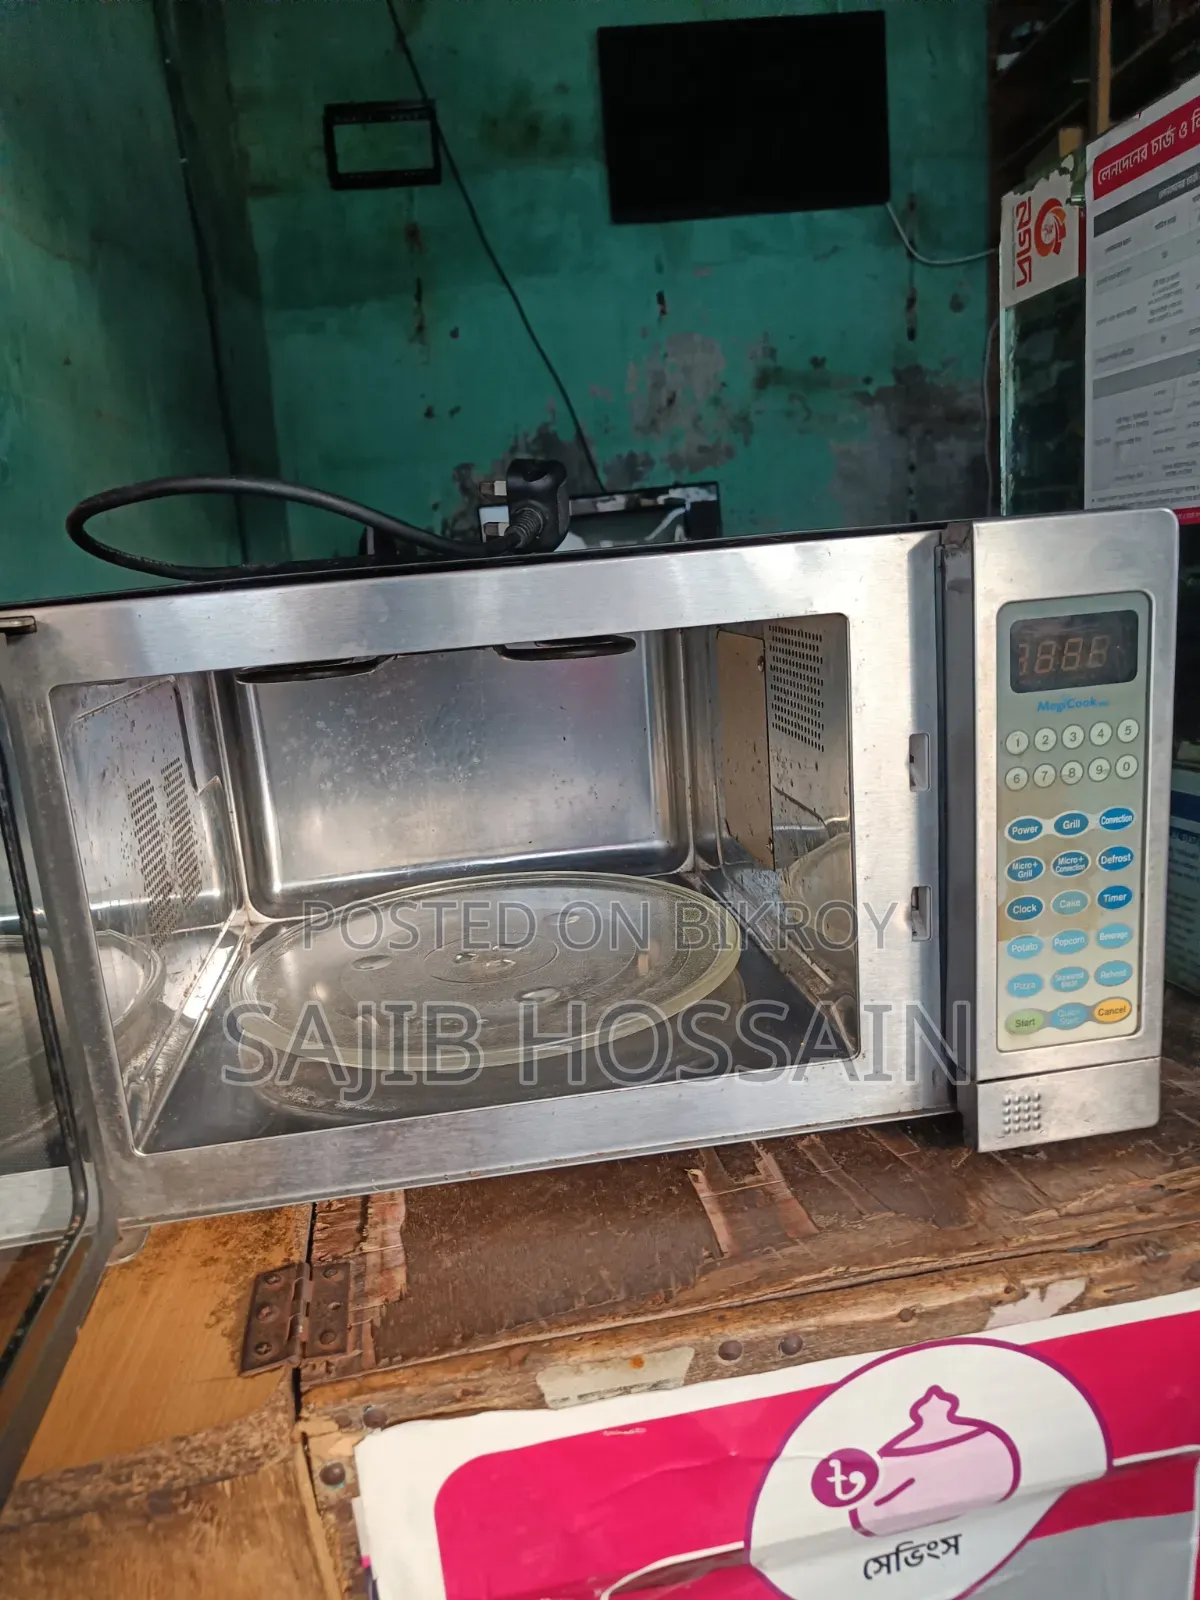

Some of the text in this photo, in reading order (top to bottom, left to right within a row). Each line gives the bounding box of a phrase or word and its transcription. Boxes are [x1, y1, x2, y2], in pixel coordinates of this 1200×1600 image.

[1097, 143, 1148, 185] লেনদেনের
[1151, 125, 1176, 155] চার্জ
[1178, 118, 1188, 139] ও
[1041, 734, 1049, 744] 2
[1069, 731, 1077, 742] 3
[1096, 728, 1104, 738] 4
[1124, 725, 1132, 735] 5
[1013, 761, 1130, 783] 6 7 8 9 0
[1063, 819, 1081, 830] Grill
[1101, 814, 1133, 825] Convection
[1012, 825, 1039, 835] Power
[1058, 856, 1084, 865] Micro+
[1101, 853, 1131, 865] Defrost
[1012, 862, 1039, 870] Micro+
[1055, 863, 1086, 873] Convection
[1018, 869, 1033, 878] Grill
[1103, 892, 1127, 902] Timer
[1012, 903, 1037, 914] Clock
[1059, 899, 1081, 908] Cake
[1100, 930, 1128, 941] Beverage
[1054, 936, 1085, 947] Popcorn
[1011, 942, 1038, 953] Potato
[1100, 968, 1127, 979] Reheat
[1014, 981, 1036, 990] Pizza
[1098, 1006, 1127, 1016] Cancel
[1015, 1018, 1036, 1028] Start
[863, 1534, 962, 1580] সেভিংস
